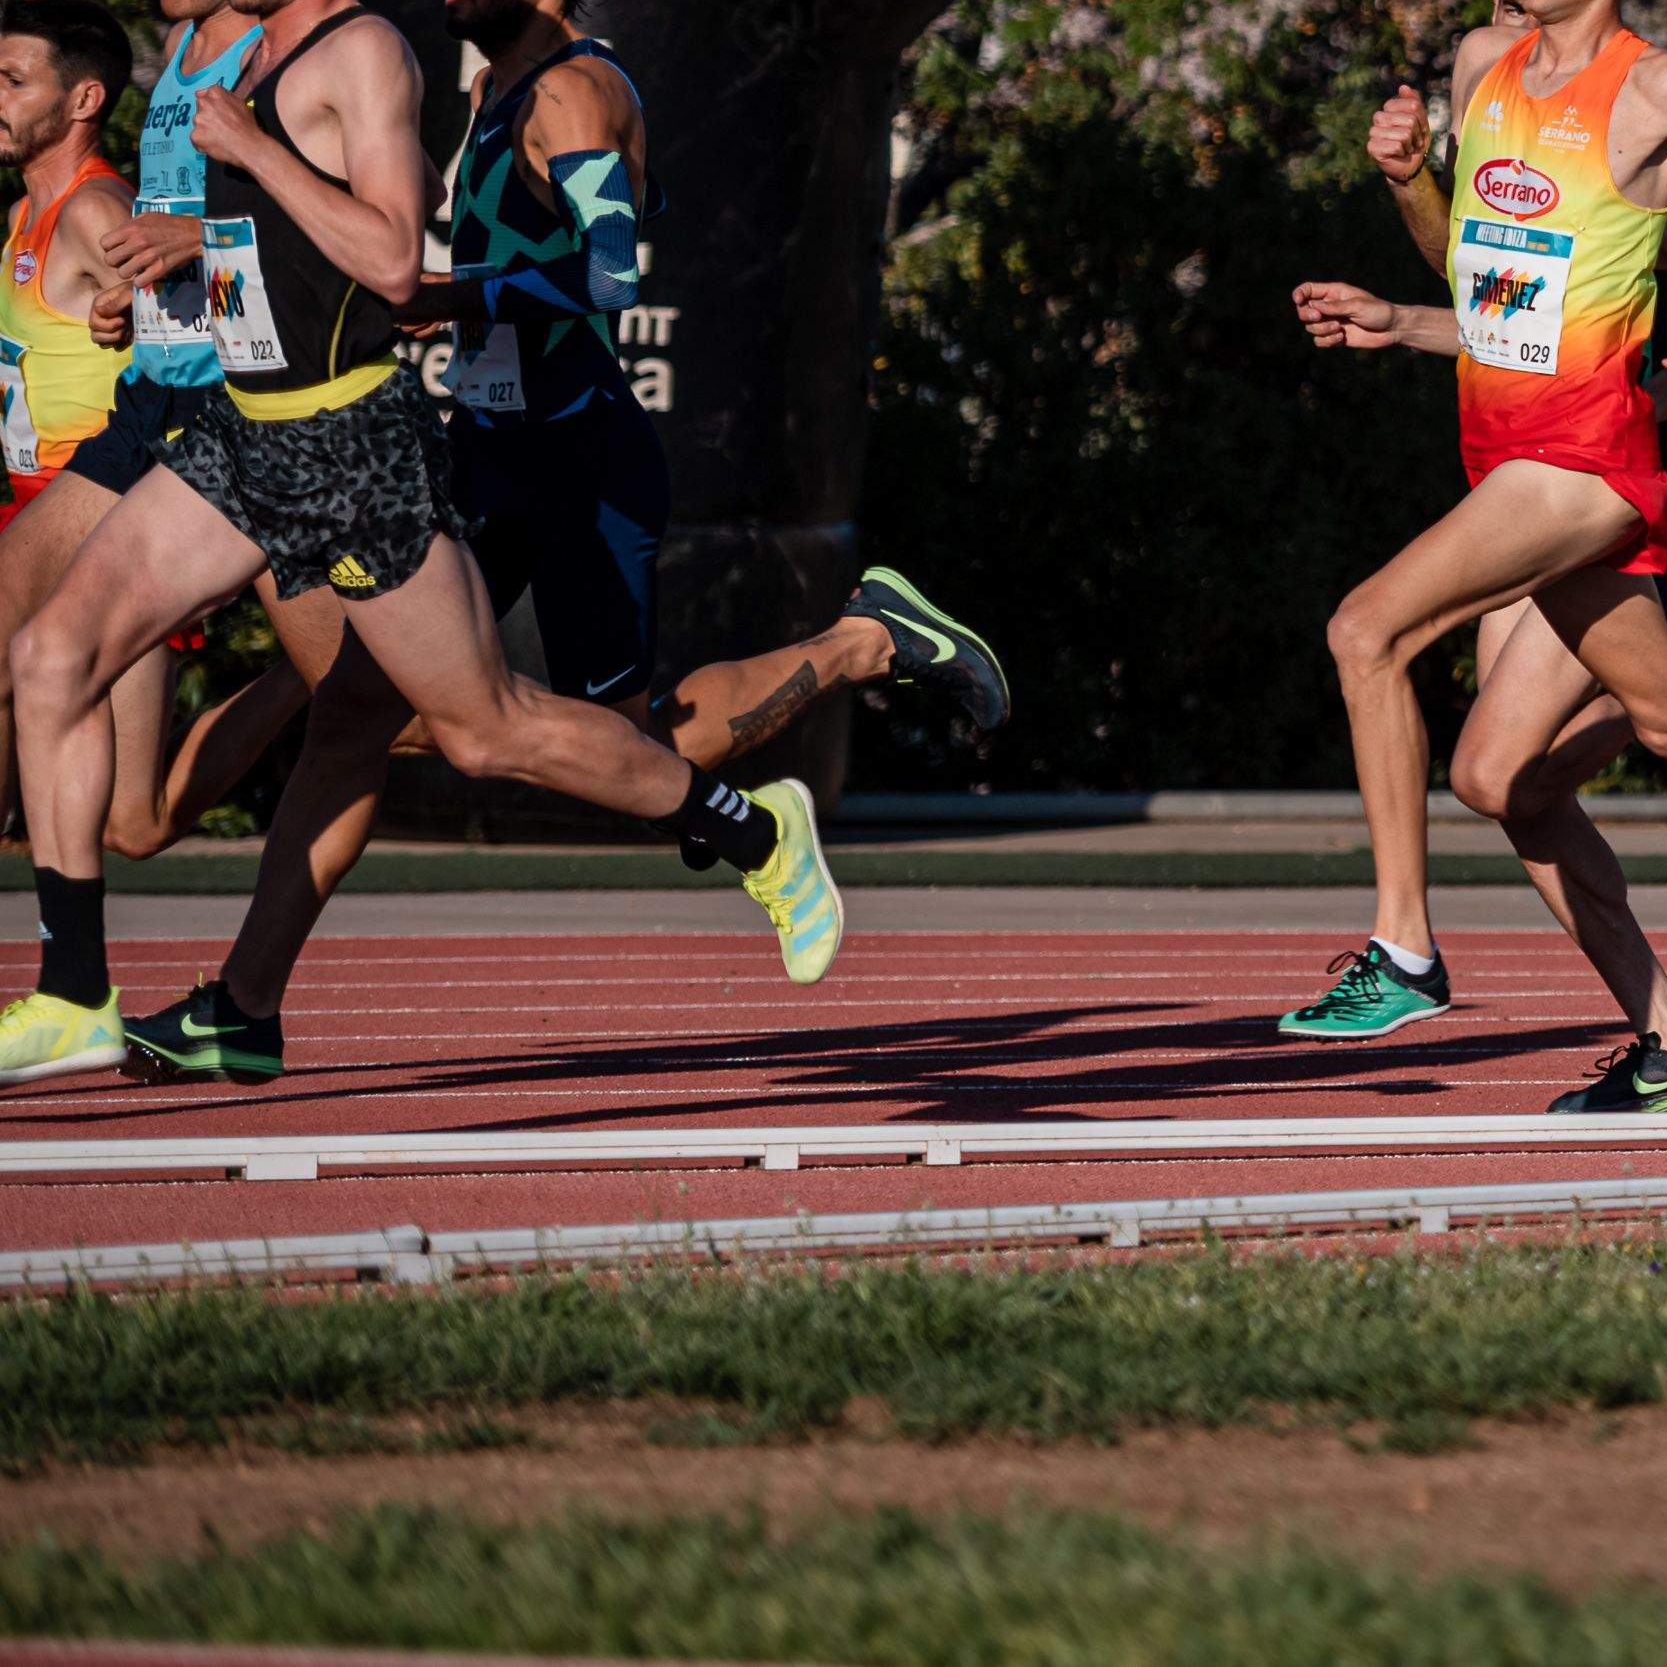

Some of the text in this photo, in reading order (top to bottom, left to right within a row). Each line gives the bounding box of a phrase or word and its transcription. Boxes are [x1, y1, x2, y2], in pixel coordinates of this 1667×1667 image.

[1482, 170, 1551, 206] Serrano
[251, 340, 276, 360] 022
[1520, 343, 1550, 364] 029
[488, 381, 514, 403] 027
[18, 448, 34, 469] 023
